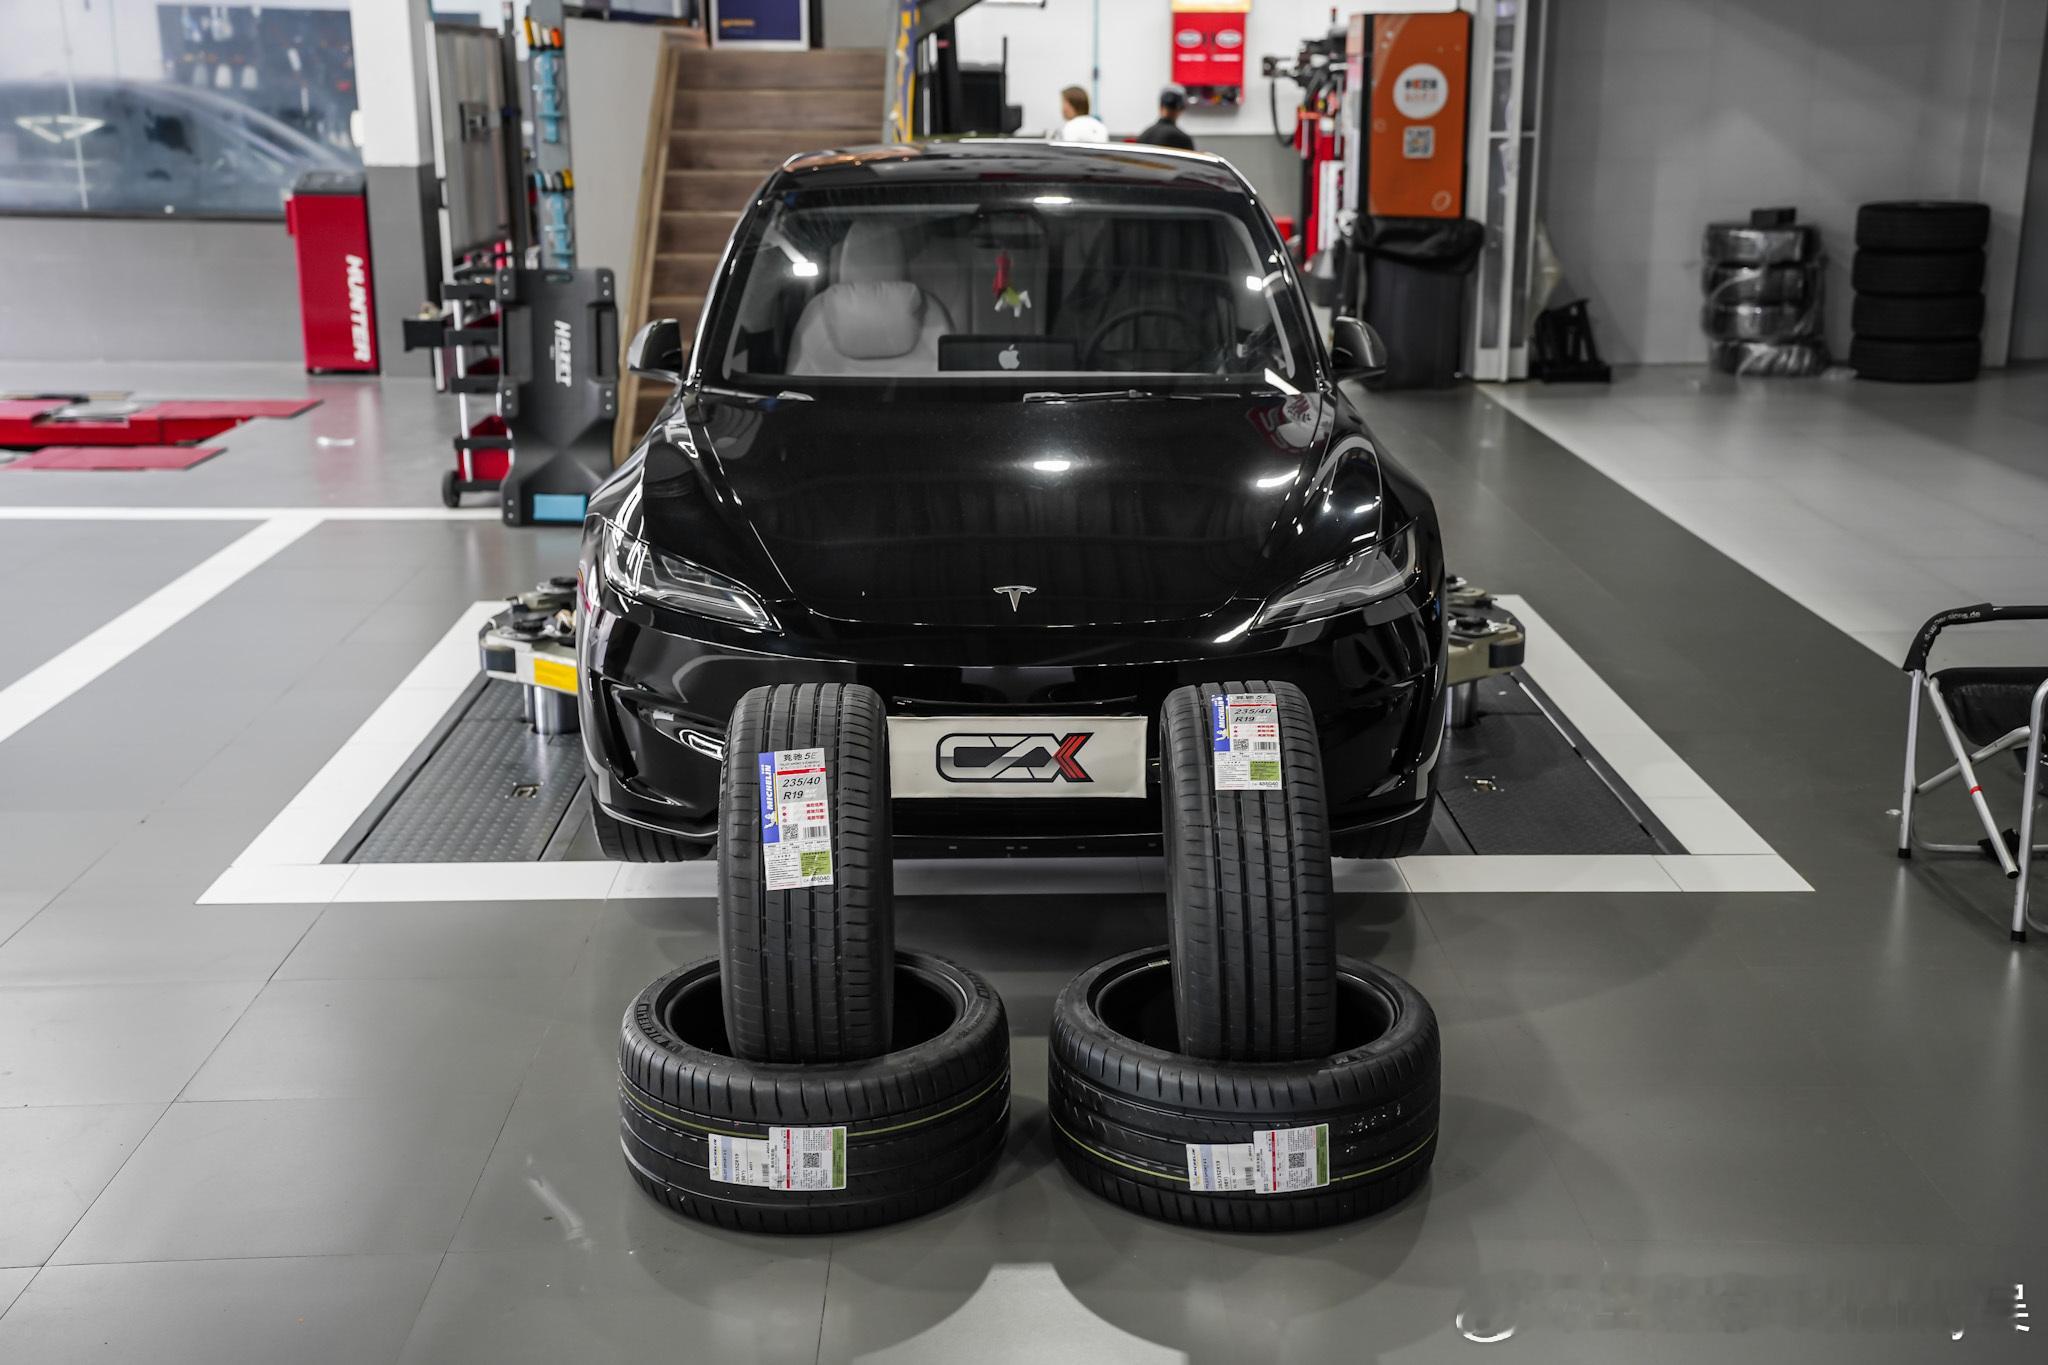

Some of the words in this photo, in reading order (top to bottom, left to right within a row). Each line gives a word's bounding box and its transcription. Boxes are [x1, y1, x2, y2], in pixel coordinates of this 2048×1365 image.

[345, 254, 371, 363] HUNTER
[554, 320, 571, 388] HAZET
[766, 764, 774, 810] MICHELIN
[782, 776, 821, 788] 235/40
[783, 790, 804, 800] R19
